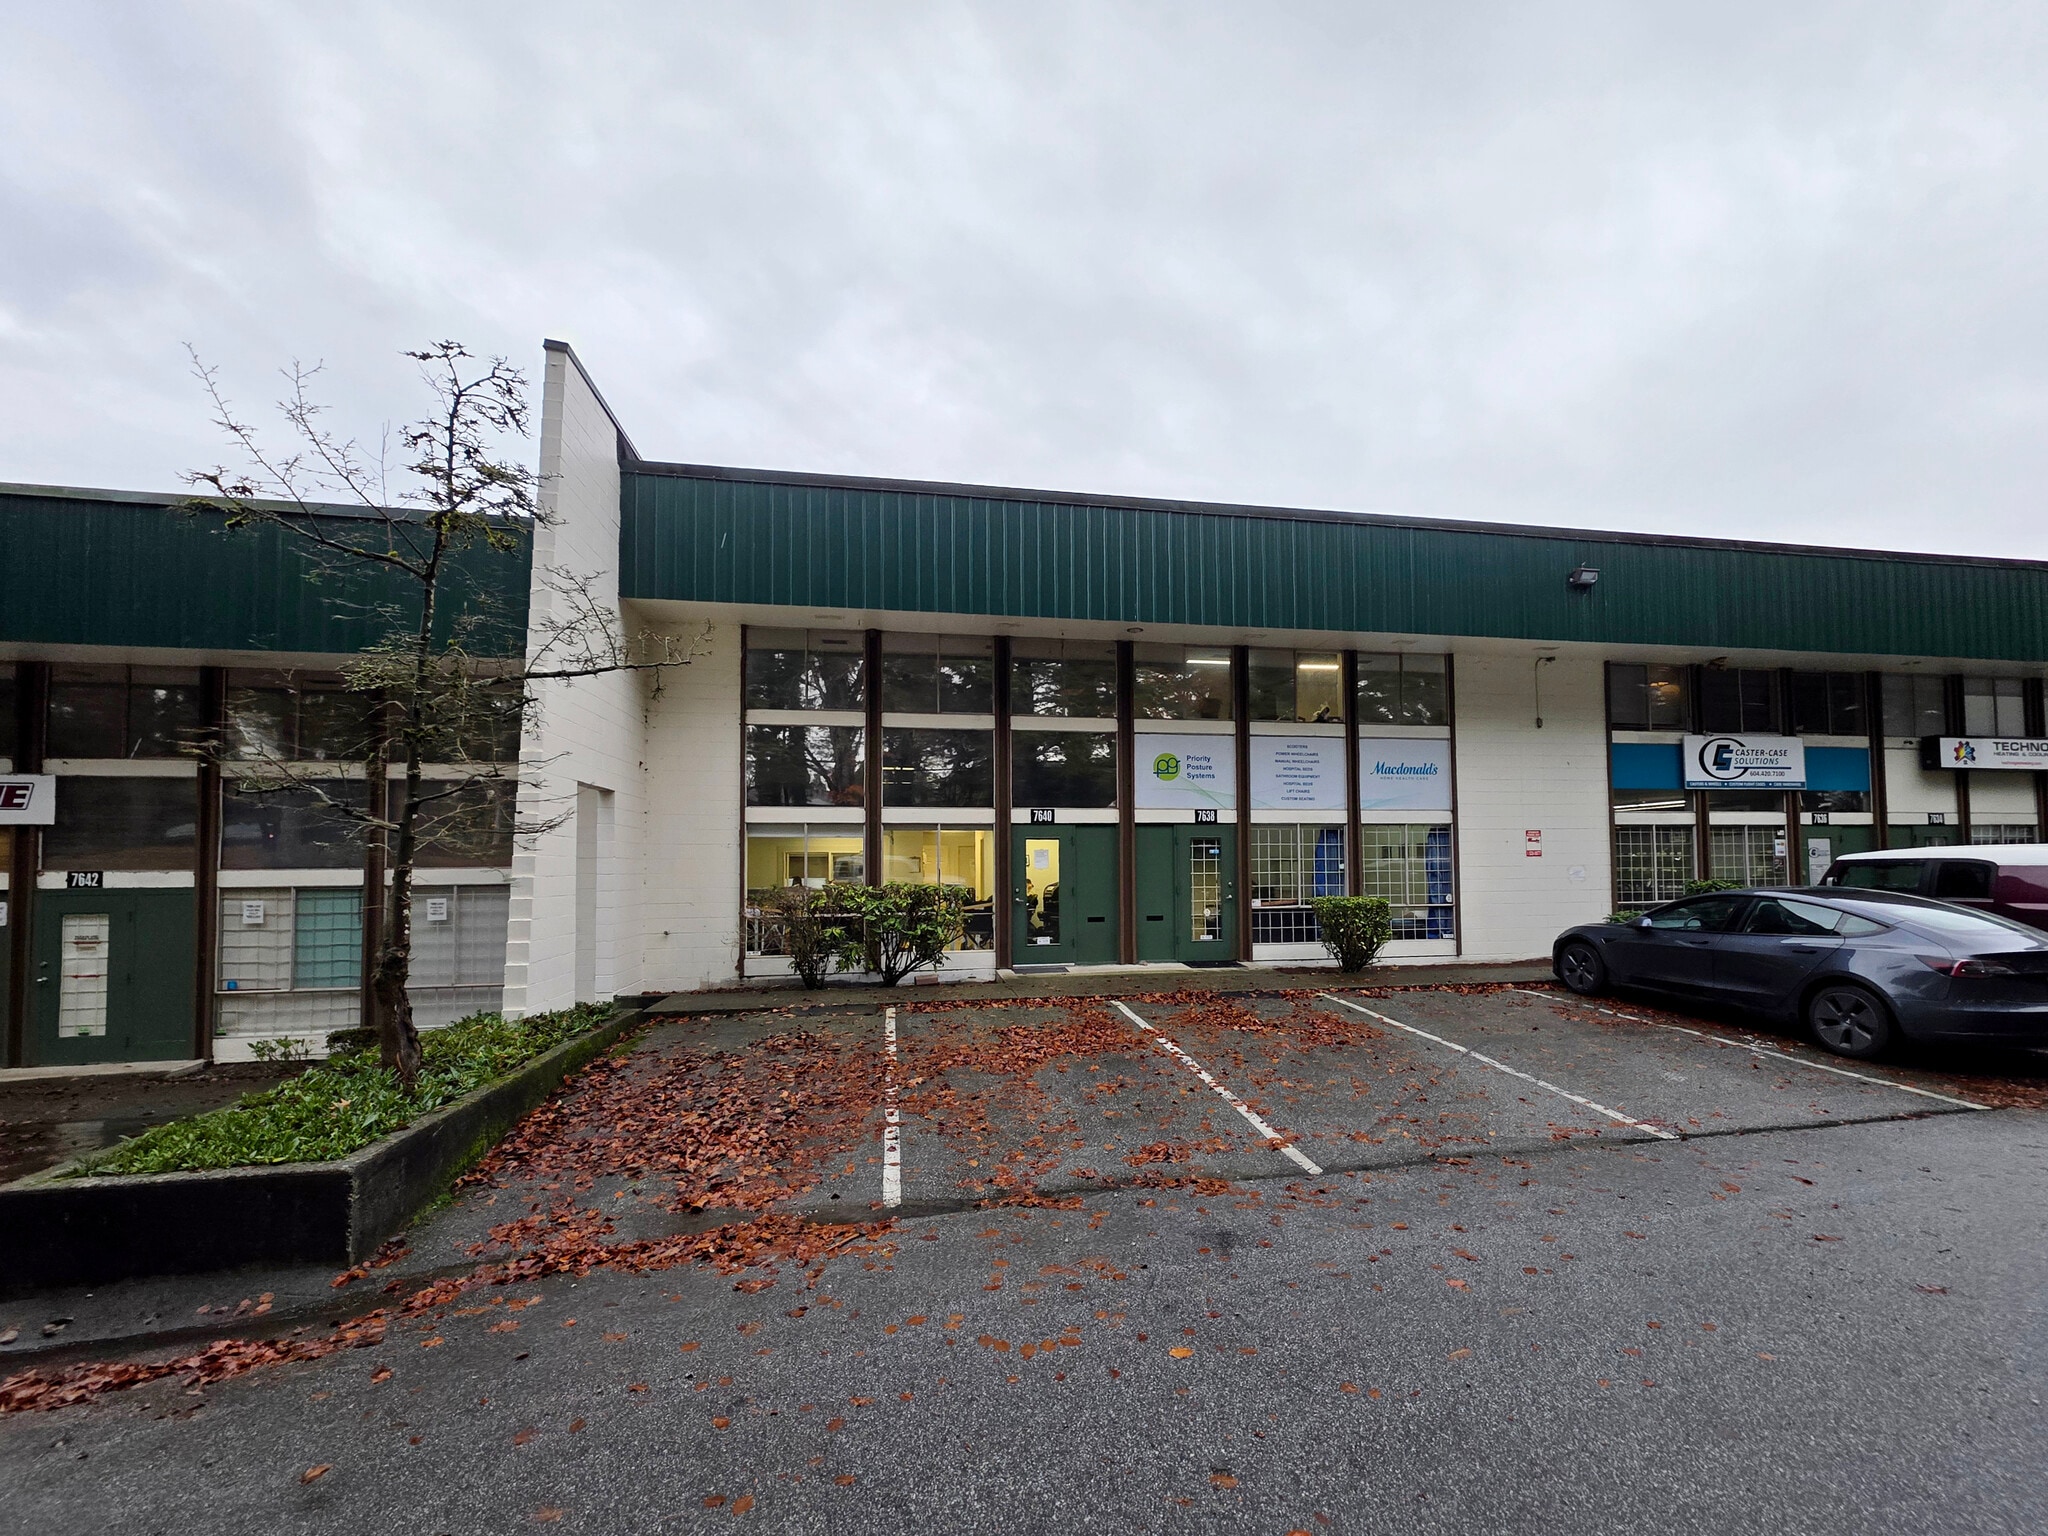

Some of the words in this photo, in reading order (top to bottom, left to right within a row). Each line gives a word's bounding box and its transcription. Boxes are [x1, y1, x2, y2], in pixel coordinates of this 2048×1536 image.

[1735, 749, 1788, 757] CASTER-CASE
[1186, 755, 1211, 763] Priority
[1734, 757, 1779, 765] SOLUTIONS
[1370, 760, 1439, 776] Macdonald's
[1186, 772, 1216, 780] Systems
[1033, 810, 1052, 822] 7640
[1197, 810, 1215, 822] 7638
[1813, 814, 1828, 824] 7636
[1929, 814, 1943, 824] 7634
[71, 872, 99, 887] 7642
